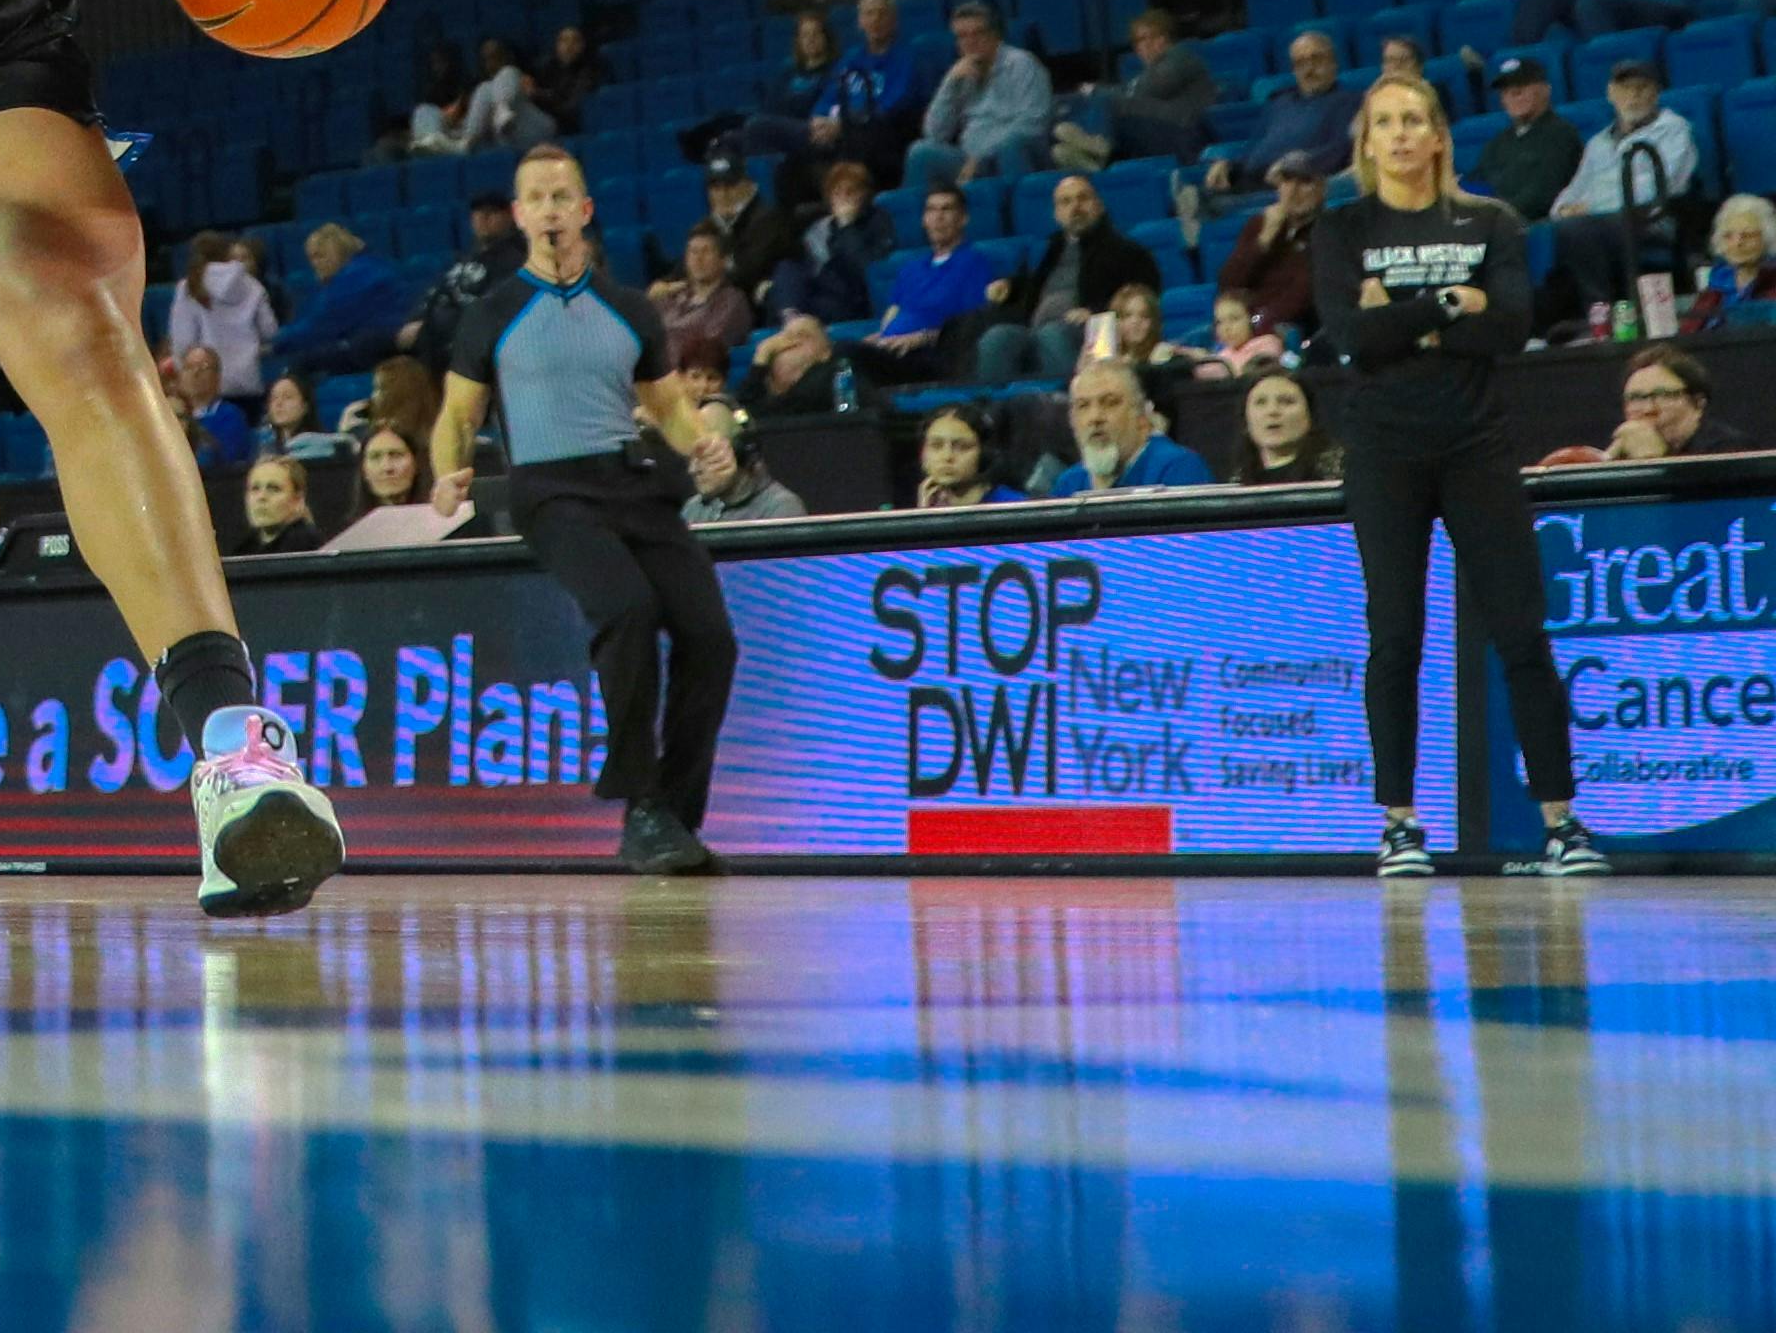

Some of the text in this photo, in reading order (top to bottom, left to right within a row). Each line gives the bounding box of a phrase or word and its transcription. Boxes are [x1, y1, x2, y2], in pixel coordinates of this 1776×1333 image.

[869, 557, 1101, 680] STOP
[1534, 513, 1768, 631] Great
[25, 697, 70, 795] a
[87, 656, 369, 795] SOER
[1069, 646, 1195, 714] New
[907, 683, 1057, 797] DWI
[1069, 724, 1195, 796] York
